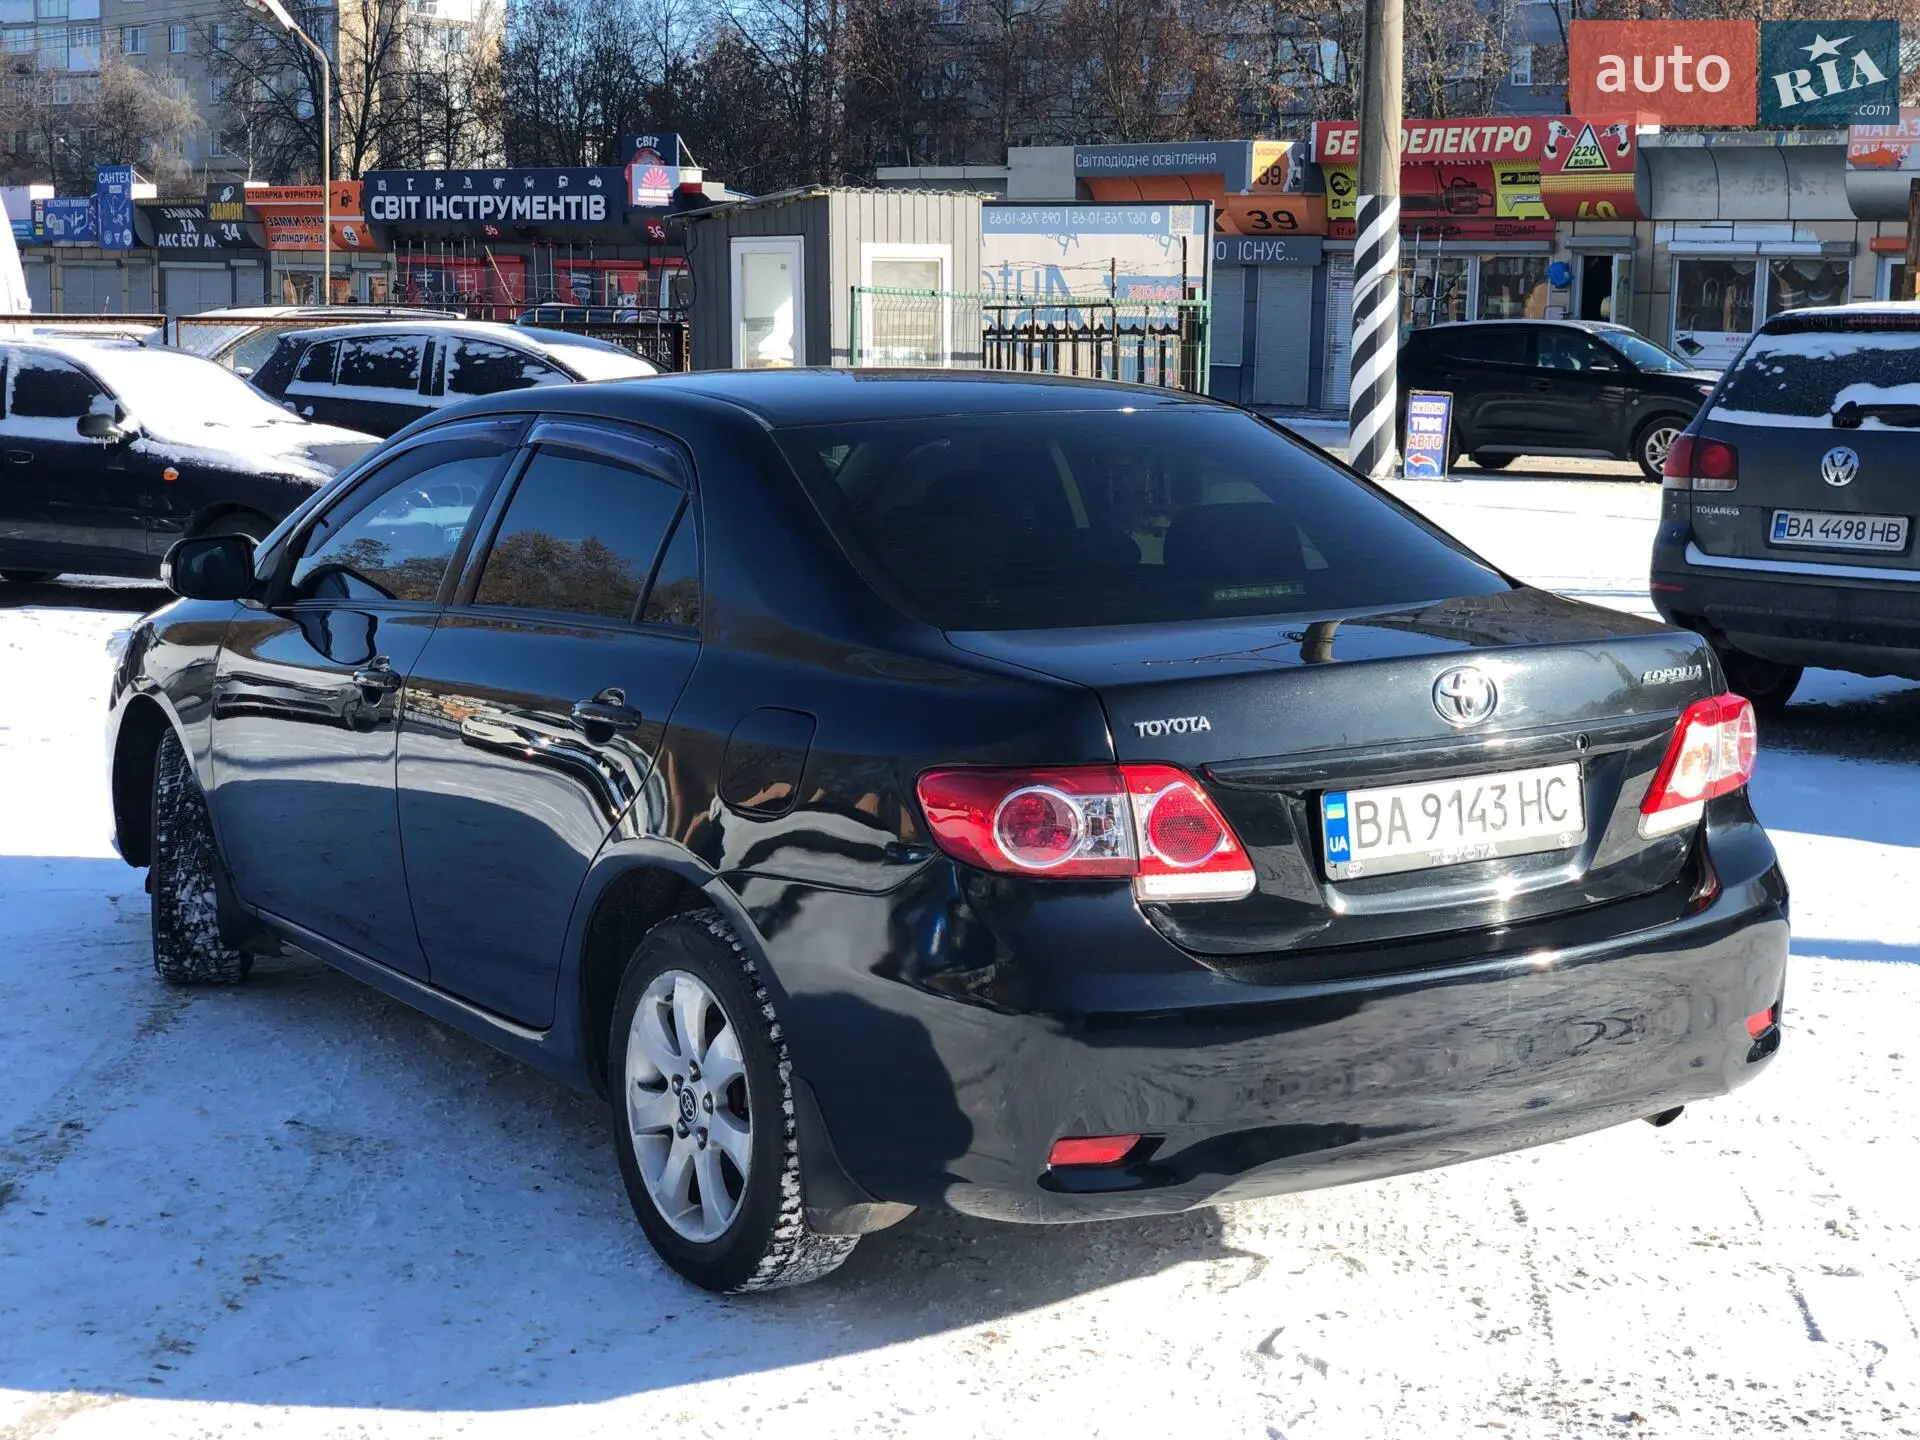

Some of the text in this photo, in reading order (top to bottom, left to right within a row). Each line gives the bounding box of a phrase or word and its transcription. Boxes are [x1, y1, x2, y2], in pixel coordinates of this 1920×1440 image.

[636, 136, 659, 149] СВІТ
[1574, 146, 1596, 157] 220
[98, 171, 130, 184] САНТЕХ
[1259, 165, 1282, 186] 39
[370, 194, 606, 221] СВІТ ІНСТРУМЕНТІВ
[1247, 210, 1298, 230] 39
[221, 223, 242, 241] 34
[344, 231, 357, 242] 35
[647, 226, 665, 238] 36
[1408, 434, 1442, 449] АВТО
[1695, 506, 1740, 516] TOUAREG
[1787, 518, 1901, 543] BA 4498 HB
[1134, 715, 1212, 738] TOYOTA
[1354, 777, 1568, 850] BA 9143 HC
[1329, 836, 1348, 853] UA
